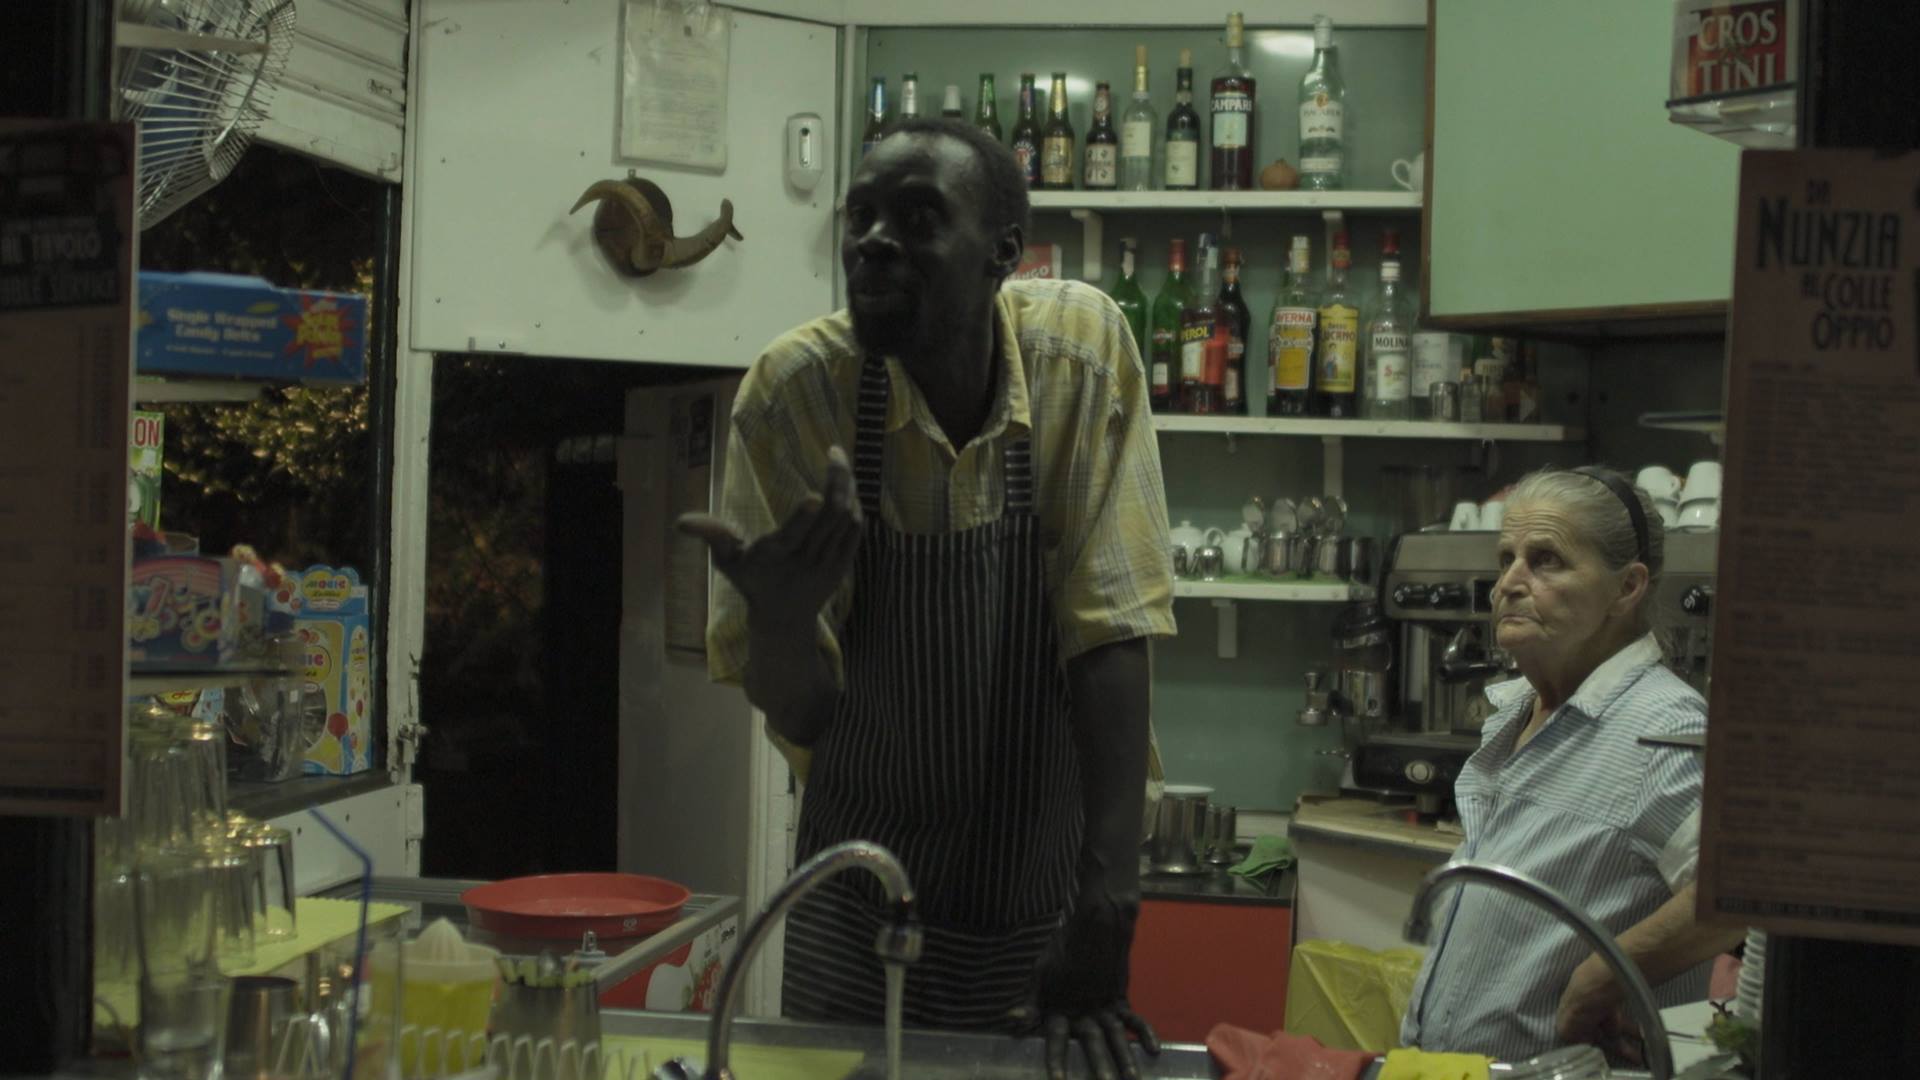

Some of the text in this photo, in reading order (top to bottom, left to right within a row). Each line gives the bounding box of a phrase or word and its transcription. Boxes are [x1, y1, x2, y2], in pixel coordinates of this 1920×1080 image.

[1699, 8, 1777, 51] CROS
[1211, 99, 1252, 111] CAMPARI
[1757, 196, 1899, 272] NUNZIA
[1824, 272, 1891, 311] COLLE
[1180, 325, 1210, 341] PEROL
[1813, 312, 1893, 350] OPPIO
[132, 418, 160, 447] ON
